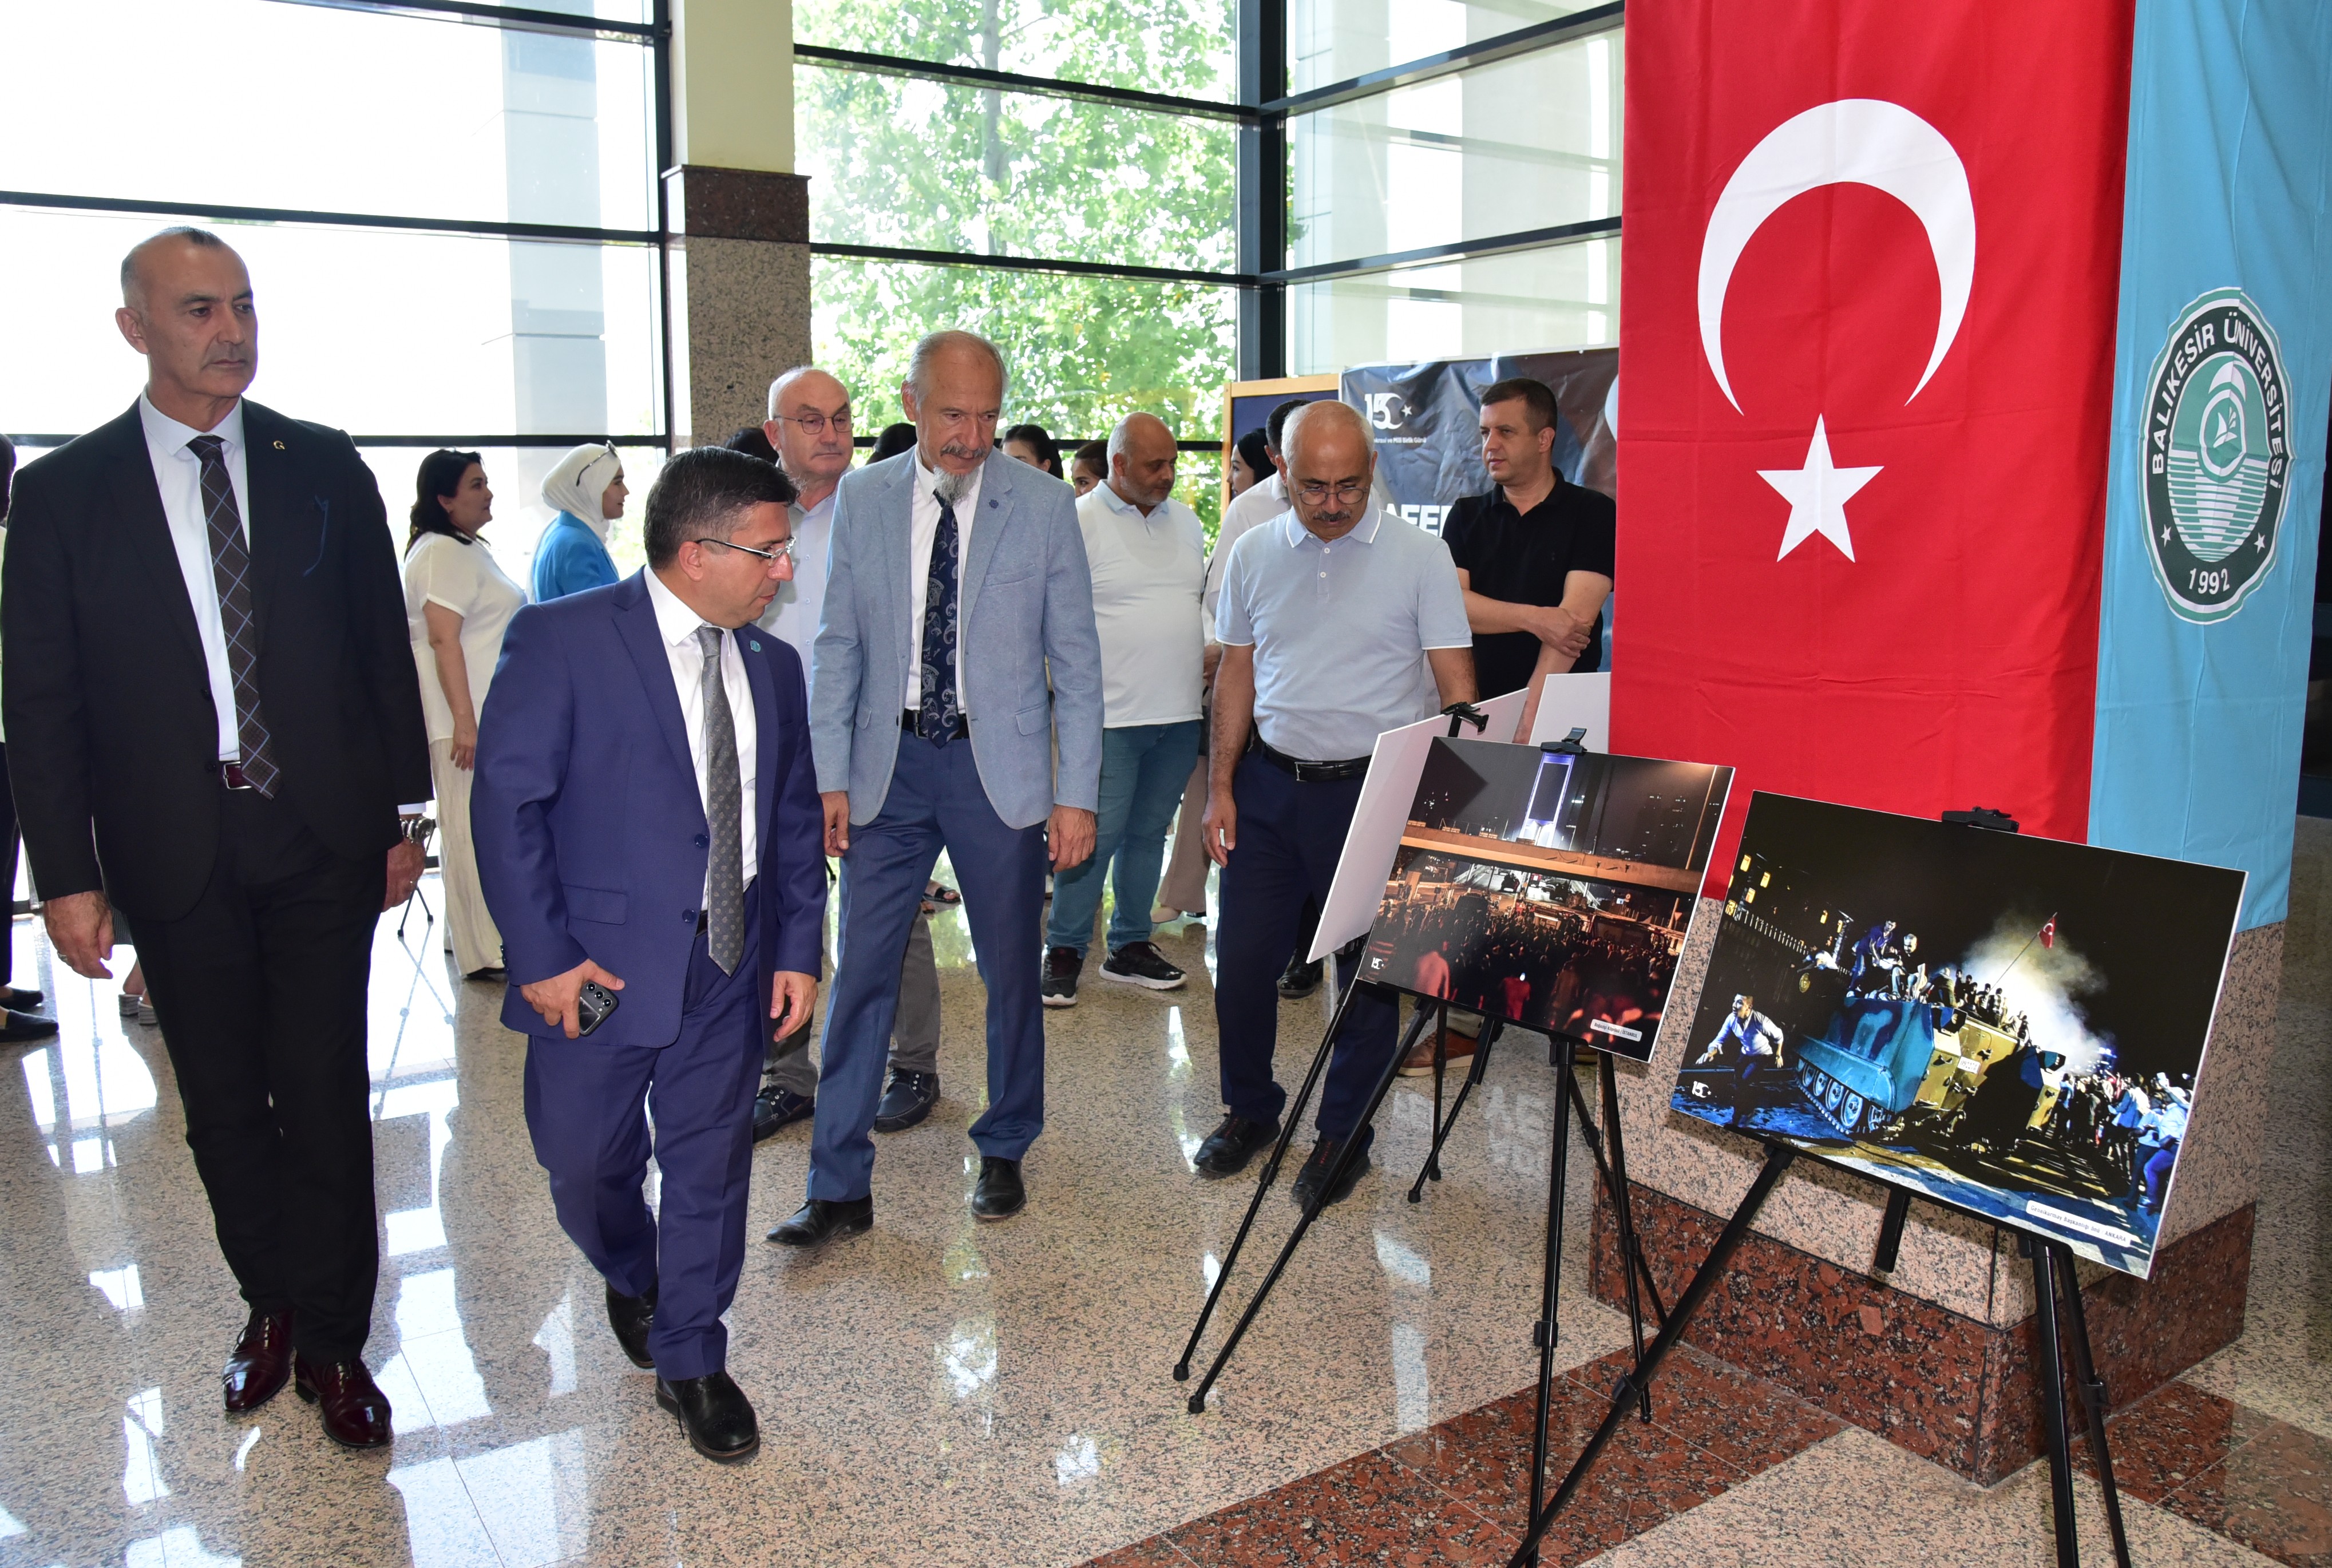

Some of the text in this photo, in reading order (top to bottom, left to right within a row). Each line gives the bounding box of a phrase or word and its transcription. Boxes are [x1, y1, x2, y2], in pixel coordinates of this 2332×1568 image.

[2152, 312, 2283, 489] BALIKESİR ÜNİVERSİTESİ
[2189, 568, 2230, 595] 1992
[2104, 1230, 2127, 1243] ANKARA
